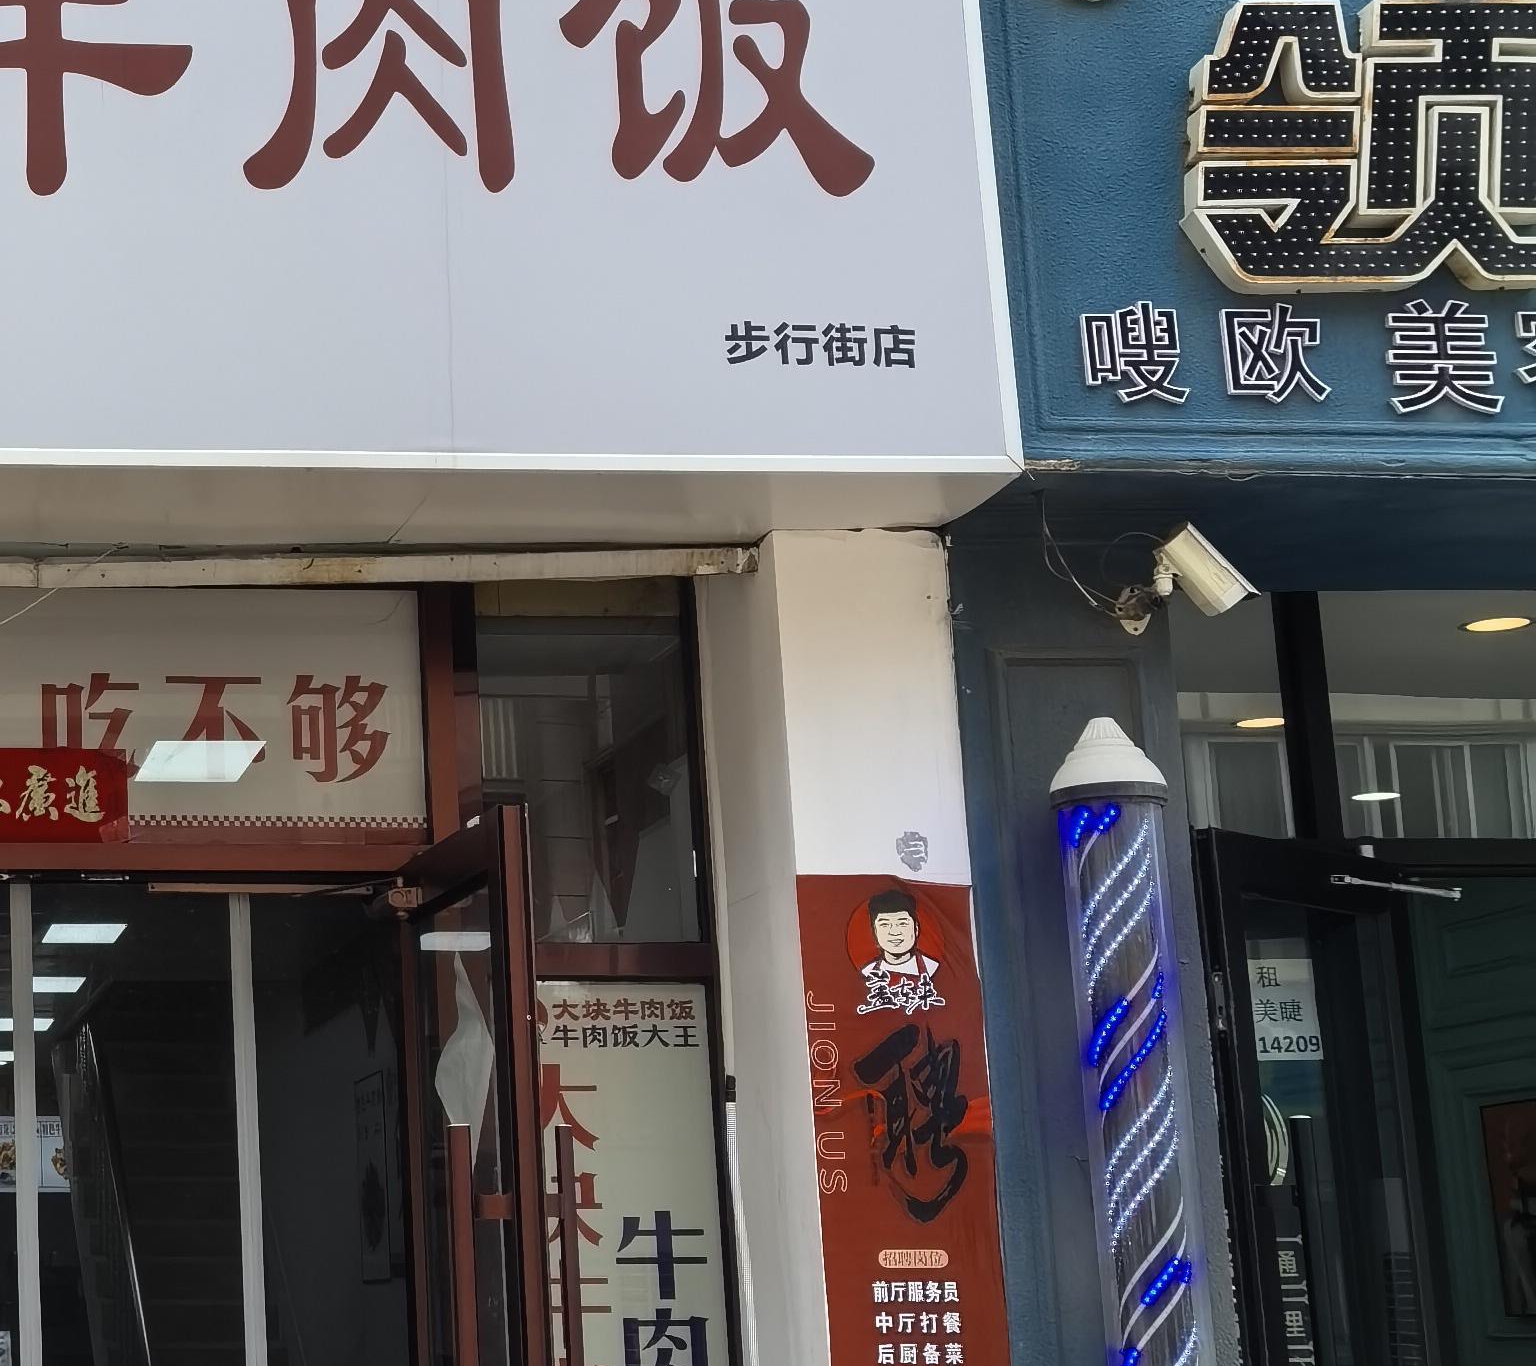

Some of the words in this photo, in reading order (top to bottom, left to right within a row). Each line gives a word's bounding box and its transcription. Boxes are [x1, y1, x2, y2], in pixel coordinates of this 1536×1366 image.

[723, 319, 917, 370] 步行街店
[1255, 966, 1282, 988] 租
[551, 997, 696, 1023] 大块牛肉饭
[1253, 998, 1304, 1024] 美睫
[550, 1024, 701, 1049] 牛肉饭大王
[1257, 1035, 1322, 1054] 14209
[851, 1023, 969, 1225] 聘
[816, 1131, 849, 1195] US
[883, 1250, 944, 1267] 招聘岗位
[871, 1280, 960, 1303] 前厅服务员
[875, 1311, 962, 1334] 中厅打餐
[877, 1342, 965, 1365] 后厨备菜
